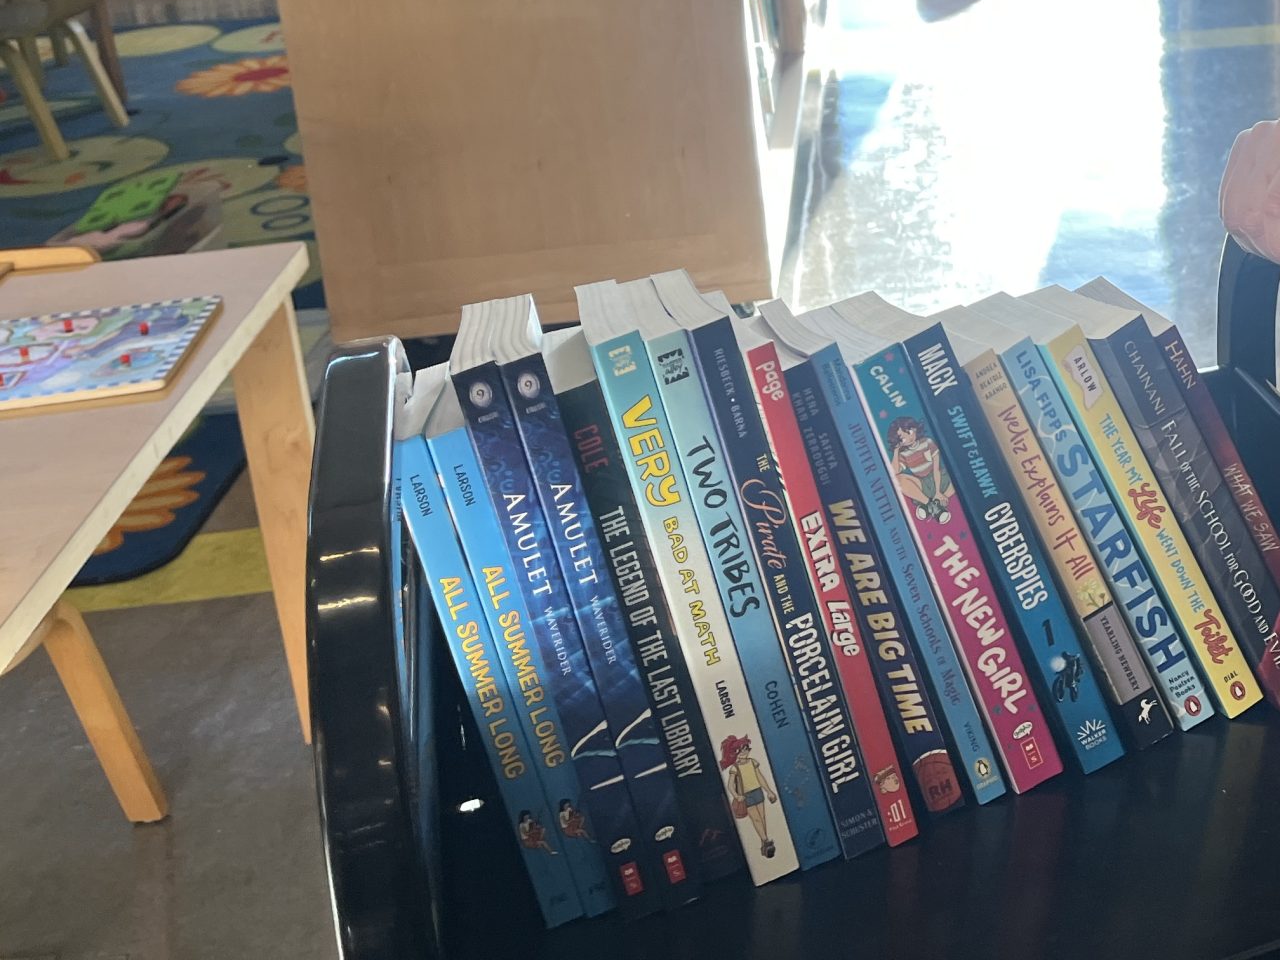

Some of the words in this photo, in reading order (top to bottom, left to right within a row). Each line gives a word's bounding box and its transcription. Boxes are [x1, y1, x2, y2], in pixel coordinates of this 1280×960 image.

[755, 360, 785, 402] page
[869, 365, 907, 408] CALIN
[917, 342, 958, 396] MACX
[1073, 356, 1098, 392] ARLOW
[1123, 340, 1166, 416] CHAINANI
[1164, 339, 1197, 390] HAHN
[713, 347, 736, 397] RIESBECK
[730, 404, 748, 439] BARNA
[791, 391, 809, 422] KHAN
[802, 386, 820, 417] HENA
[1015, 350, 1042, 392] LISA
[1035, 392, 1068, 443] FIPPS
[573, 423, 609, 474] COLE
[621, 394, 682, 507] VERY
[818, 431, 840, 470] SAFIYA
[997, 404, 1029, 456] Iveliz
[1099, 412, 1118, 441] THE
[756, 452, 771, 473] THE
[1110, 438, 1133, 469] YEAR
[1125, 467, 1144, 487] MY
[410, 474, 434, 517] LARSON
[453, 463, 476, 507] LARSON
[1020, 454, 1065, 527] Explains
[1128, 482, 1166, 529] Life
[1224, 463, 1256, 498] WHAT
[1240, 499, 1264, 523] WE
[503, 493, 553, 596] AMULET
[551, 483, 599, 585] AMULET
[599, 505, 631, 543] THE
[662, 516, 689, 563] BAD
[687, 434, 728, 509] TWO
[709, 511, 760, 619] TRIBES
[740, 478, 788, 570] Pirate
[828, 498, 867, 546] WE
[1053, 527, 1078, 552] It
[1156, 528, 1179, 558] WENT
[1161, 419, 1188, 463] FALL
[1191, 489, 1231, 555] SCHOOL
[1224, 552, 1240, 573] FOR
[1233, 569, 1263, 615] GOOD
[1253, 613, 1270, 634] AND
[610, 541, 650, 608] LEGEND
[679, 569, 700, 595] AT
[845, 552, 889, 607] ARE
[849, 422, 878, 476] JUPITER
[870, 476, 896, 526] NETTLE
[902, 562, 922, 604] Seven
[917, 603, 943, 655] Schools
[941, 668, 962, 707] Magic
[933, 535, 981, 589] THE
[984, 502, 1048, 611] CYBERSPIES
[1056, 443, 1188, 674] STARFISH
[1065, 554, 1095, 581] All
[1170, 557, 1196, 592] DOWN
[773, 573, 787, 595] AND
[780, 594, 795, 615] THE
[799, 510, 841, 593] EXTRA
[825, 599, 860, 657] Large
[1187, 589, 1205, 614] THE
[544, 605, 572, 676] WAVERIDER
[590, 595, 617, 665] WAVERIDER
[629, 605, 657, 628] OF
[689, 600, 722, 667] MATH
[866, 611, 906, 662] BIG
[952, 587, 1005, 647] NEW
[1042, 618, 1056, 647] 1
[1194, 608, 1234, 665] Toilet
[481, 565, 510, 610] ALL
[498, 610, 545, 707] SUMMER
[529, 706, 565, 769] LONG
[636, 629, 668, 667] THE
[1099, 615, 1123, 655] YEARLING
[1117, 654, 1140, 692] NEWBERY
[439, 577, 469, 621] ALL
[456, 621, 505, 718] SUMMER
[487, 716, 526, 780] LONG
[647, 664, 682, 709] LAST
[715, 679, 736, 719] LARSON
[785, 611, 845, 740] PORCELAIN
[821, 734, 860, 794] GIRL
[887, 663, 934, 735] TIME
[977, 646, 1028, 715] GIRL
[1168, 669, 1190, 685] Nancy
[1174, 684, 1196, 699] Books
[764, 680, 790, 730] COHEN
[661, 710, 702, 778] LIBRARY
[963, 721, 981, 753] VIKING
